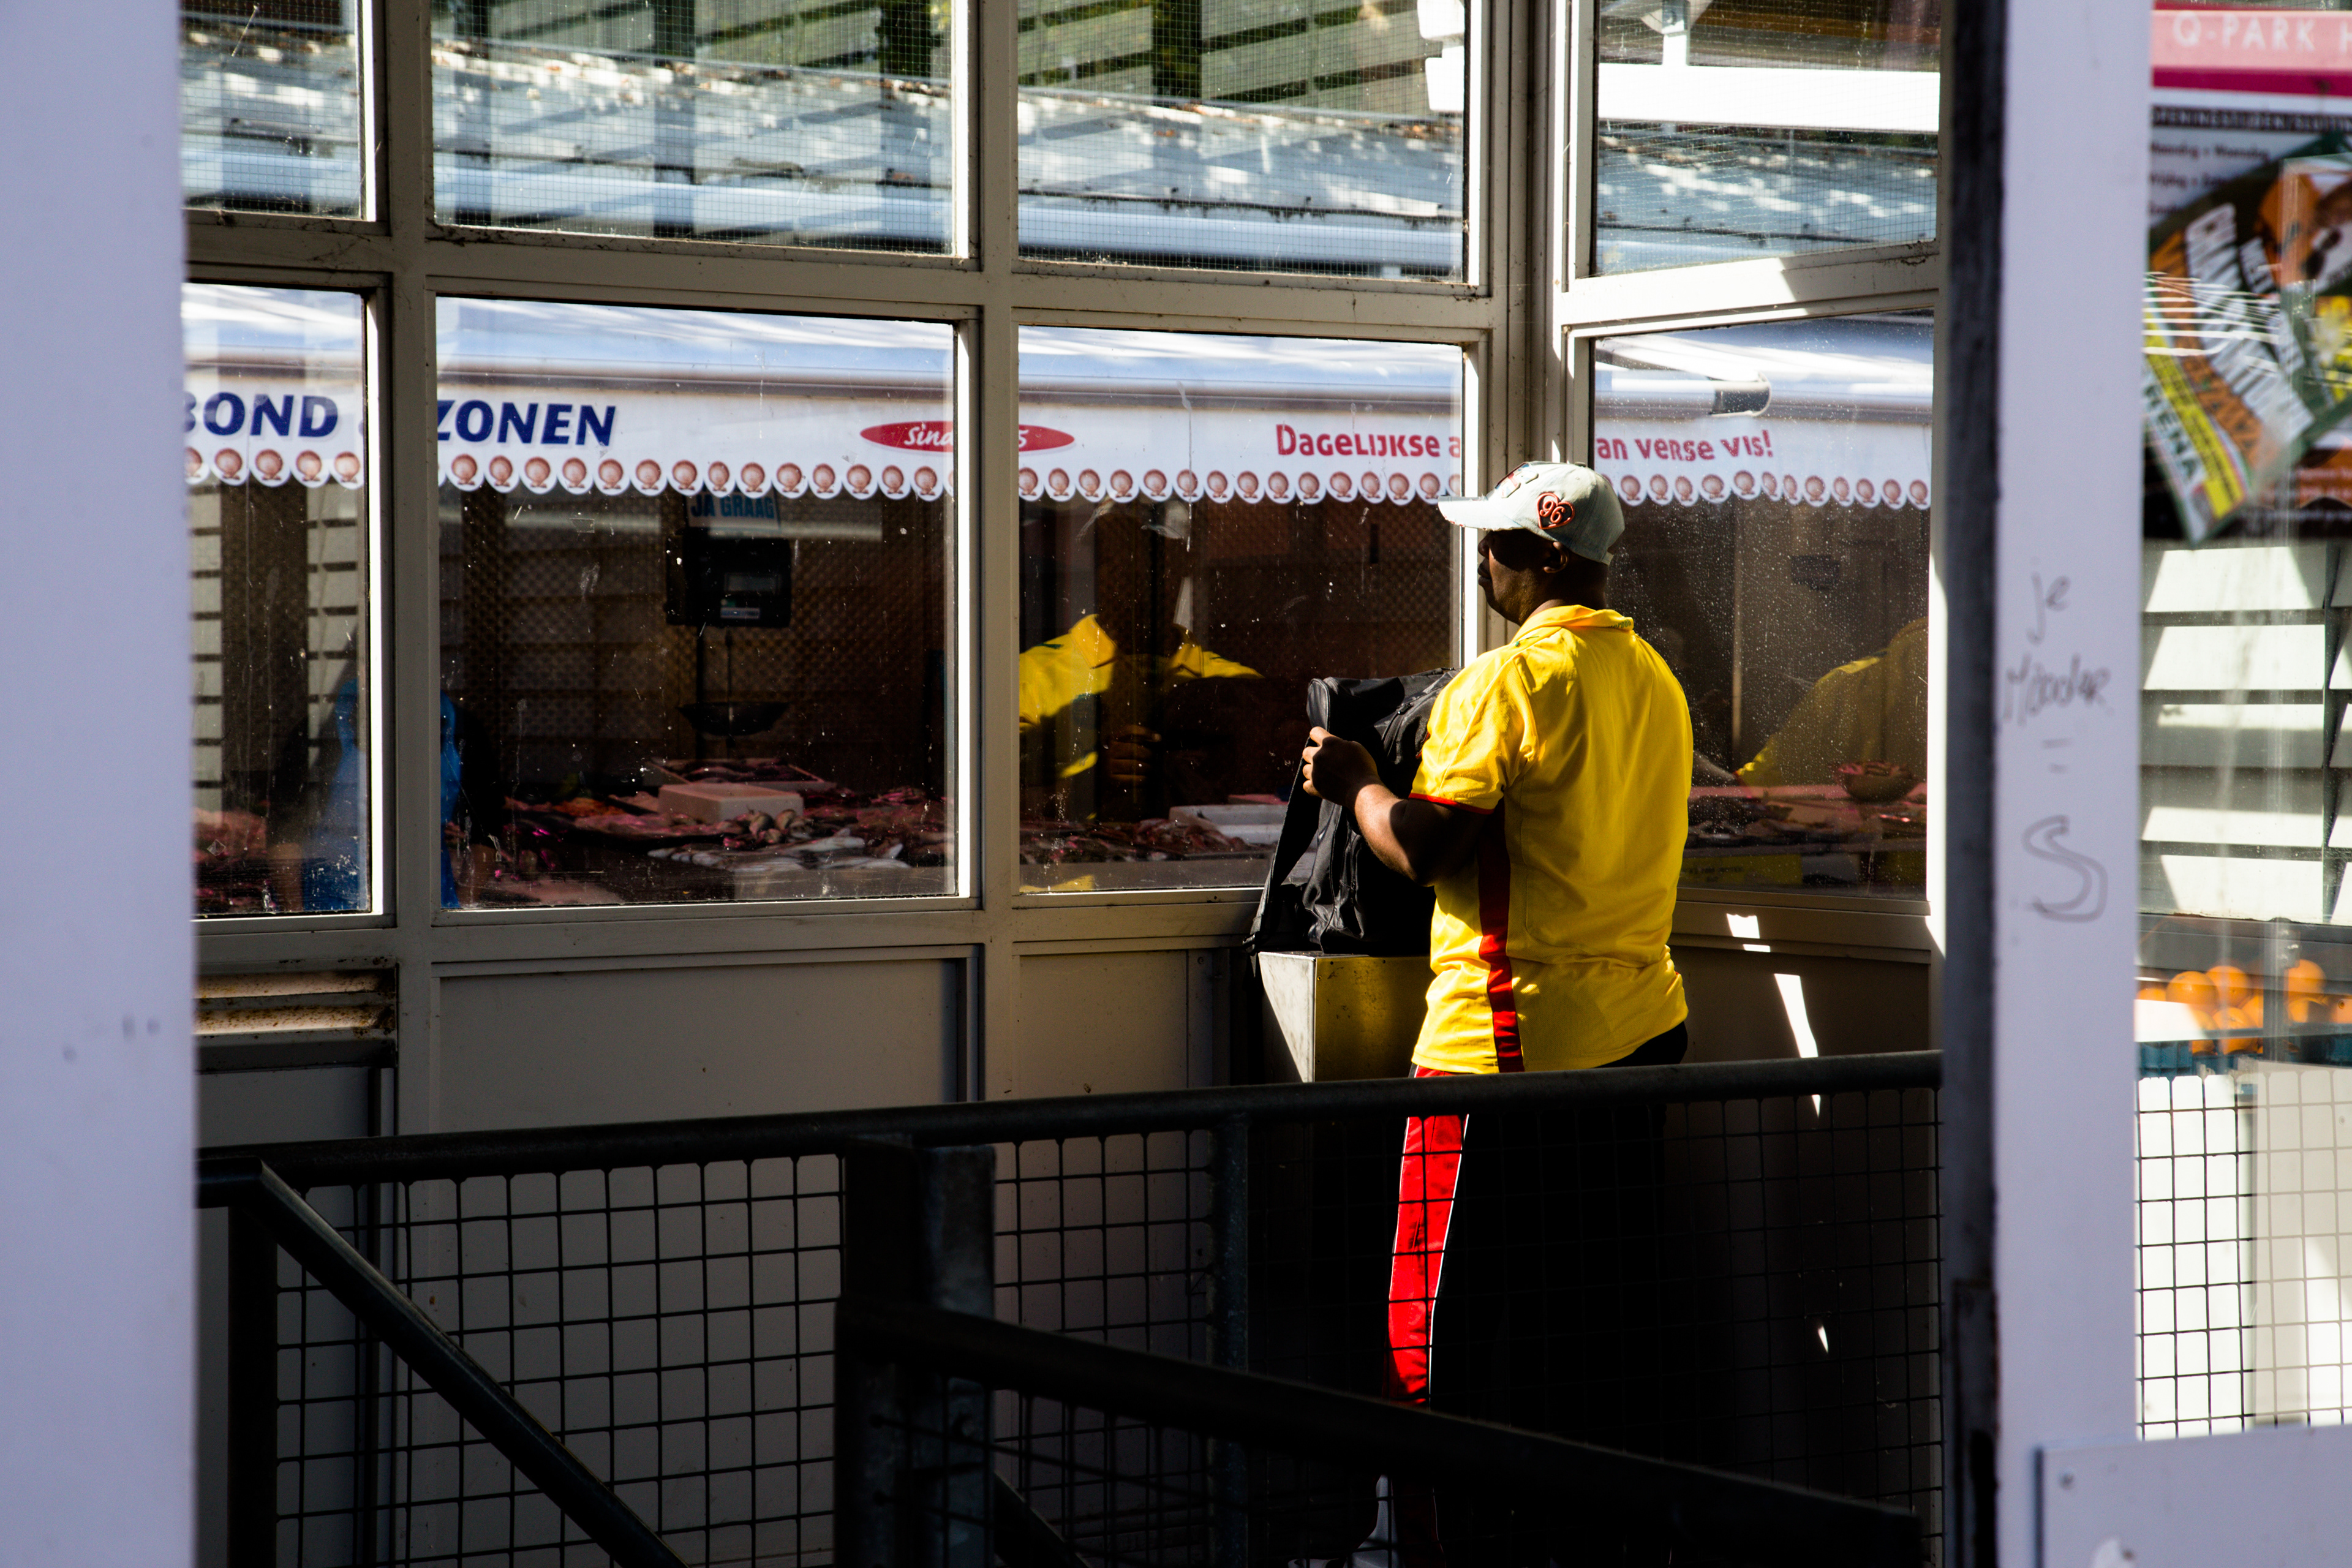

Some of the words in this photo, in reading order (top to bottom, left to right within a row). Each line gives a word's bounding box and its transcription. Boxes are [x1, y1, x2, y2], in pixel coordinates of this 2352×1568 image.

[2173, 10, 2316, 52] Q-PARK
[437, 399, 616, 446] ZONEN
[690, 494, 715, 517] JA
[720, 495, 776, 519] GRAAG
